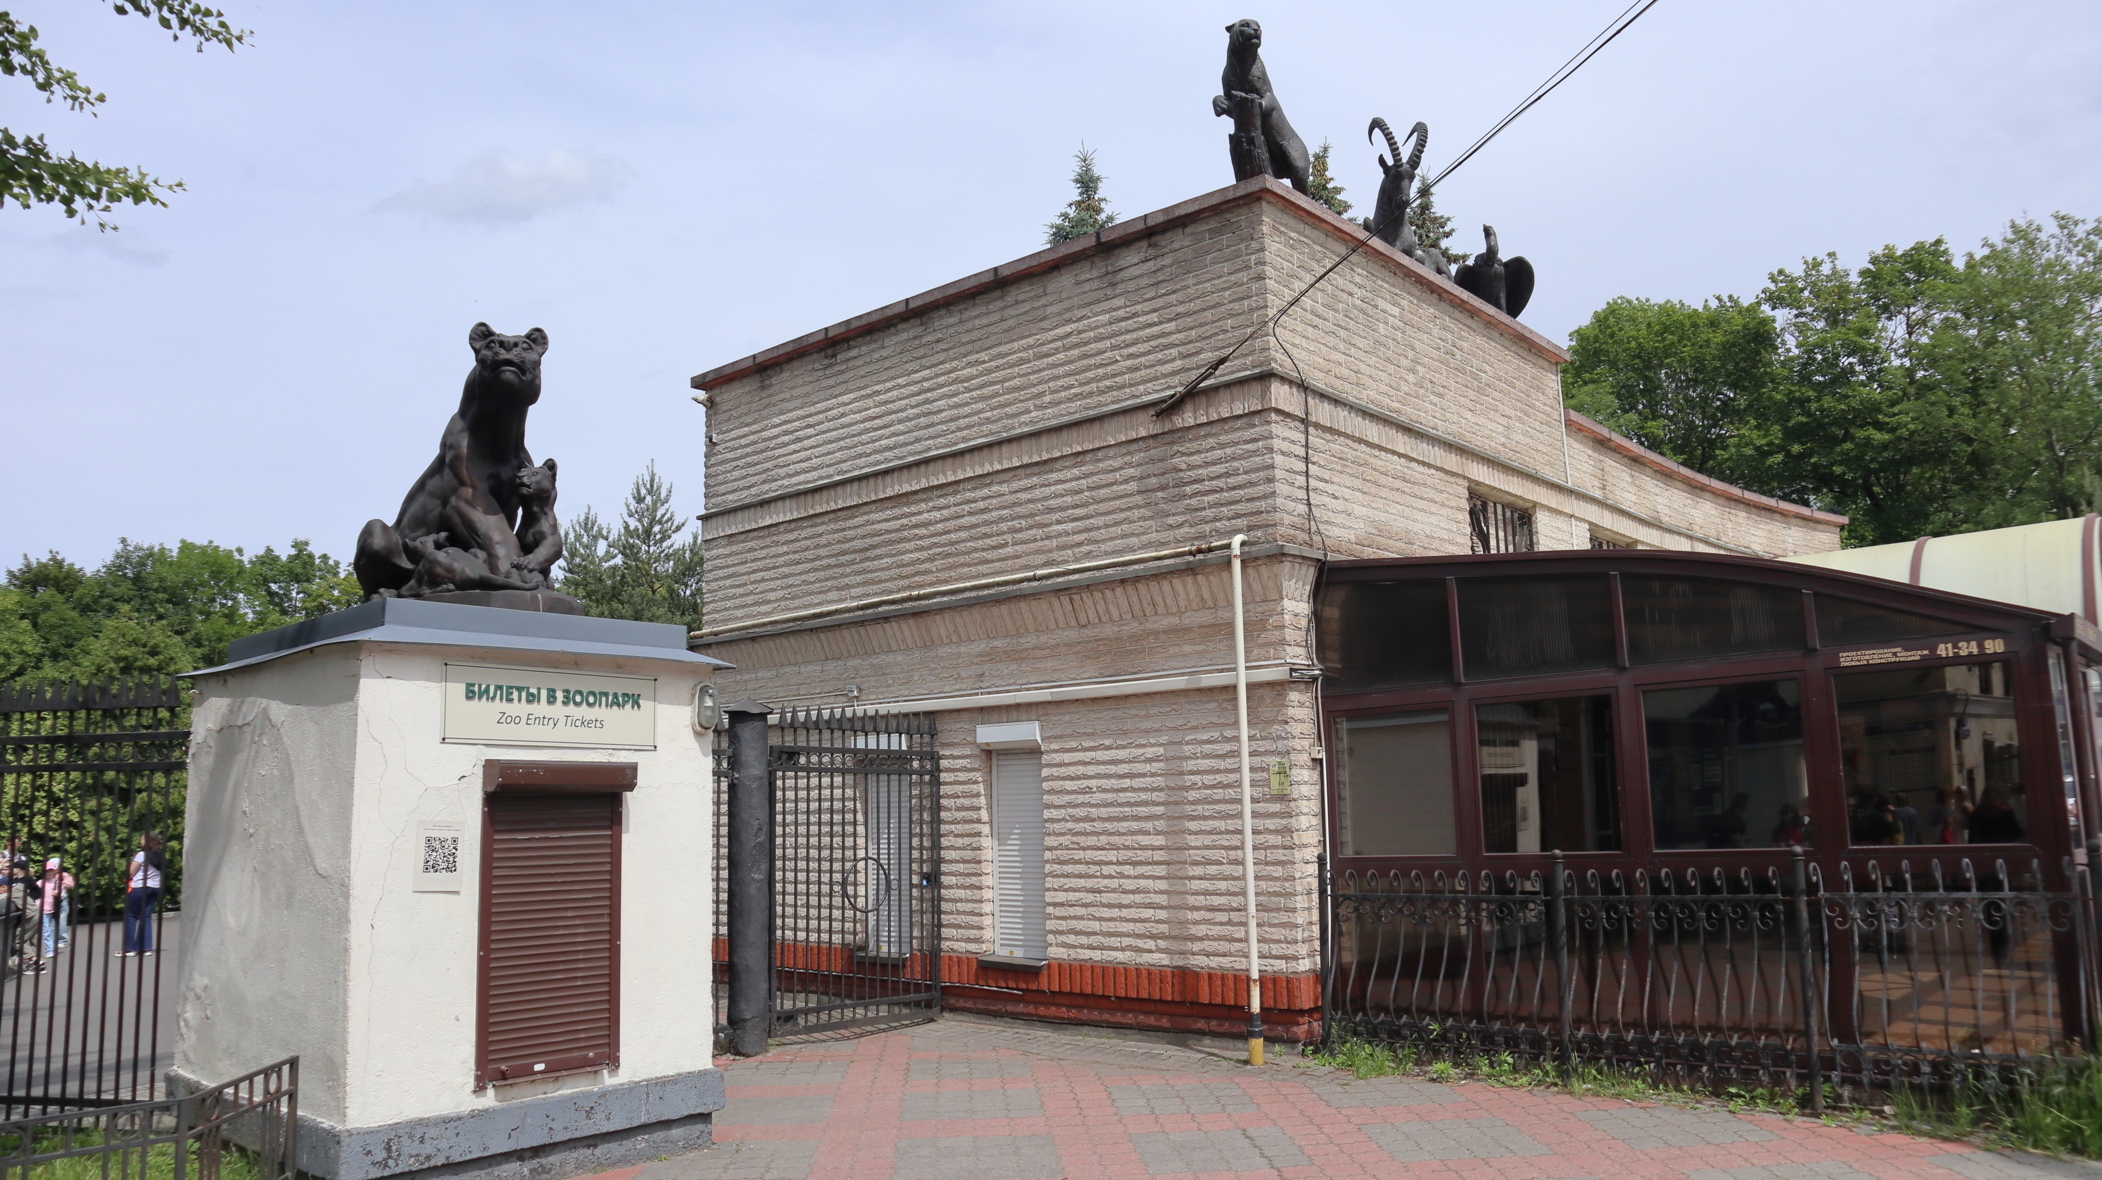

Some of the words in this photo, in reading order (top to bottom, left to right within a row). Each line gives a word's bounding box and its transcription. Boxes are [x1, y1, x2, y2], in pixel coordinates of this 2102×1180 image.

[1937, 641, 1978, 657] 41-34
[1984, 638, 2005, 653] 90
[464, 682, 541, 704] БИЛЕТЫ
[546, 687, 558, 703] В
[561, 689, 642, 710] ЗООПАРК
[496, 711, 522, 726] Zoo
[525, 712, 560, 730] Entry
[563, 714, 605, 730] Tickets
